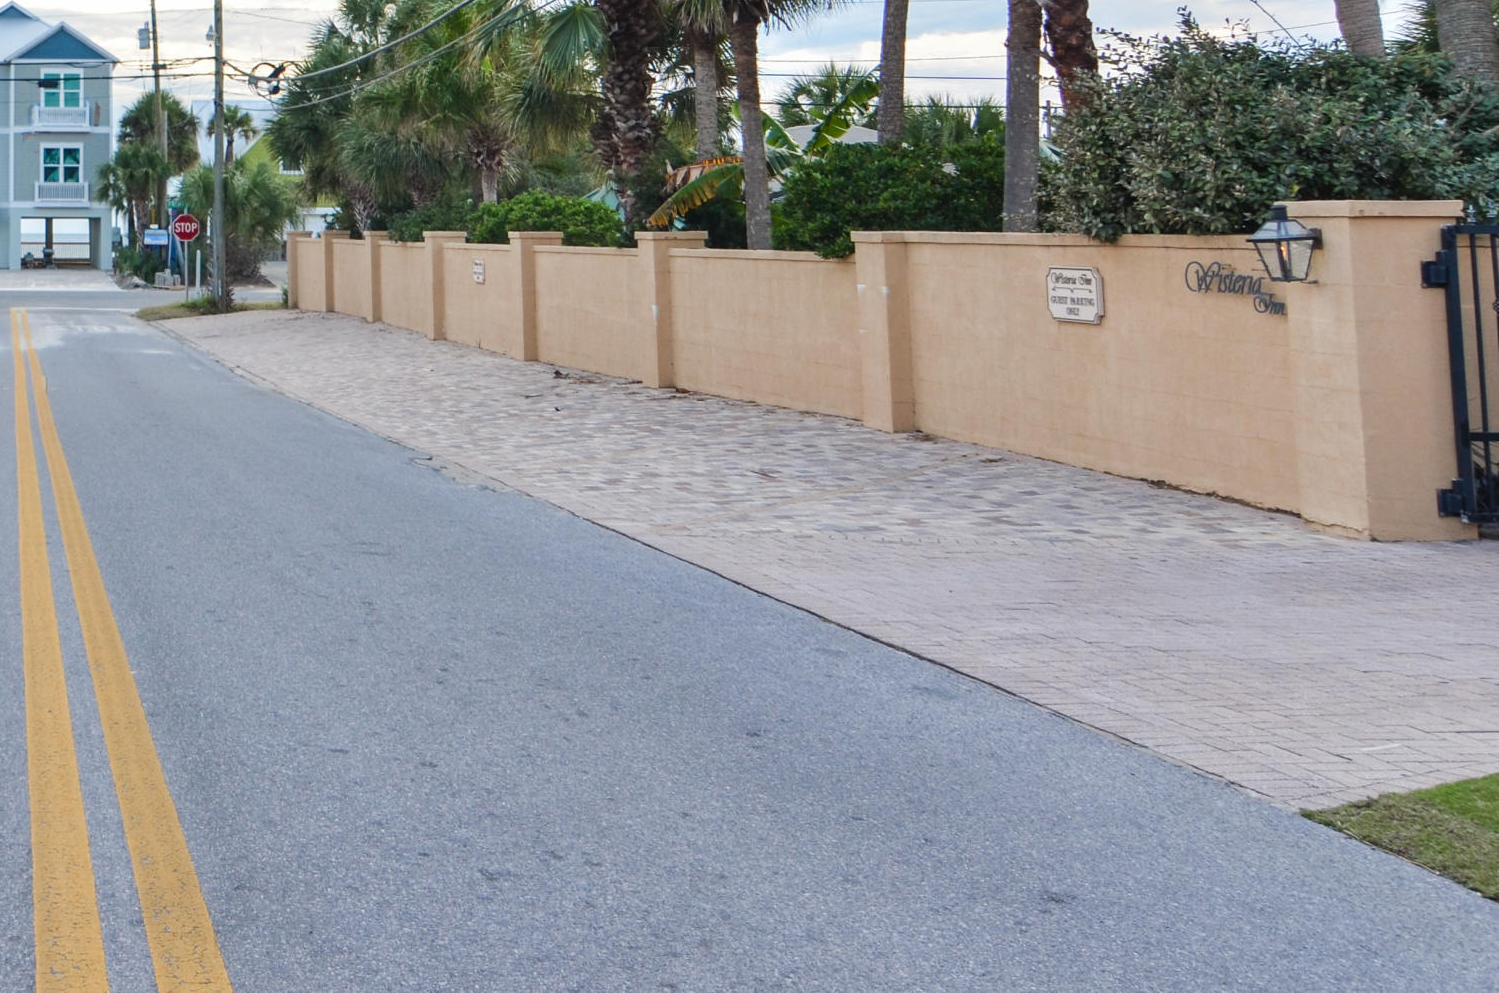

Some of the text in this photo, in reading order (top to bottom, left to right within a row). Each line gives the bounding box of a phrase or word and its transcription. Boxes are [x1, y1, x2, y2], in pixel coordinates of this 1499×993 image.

[175, 223, 198, 233] STOP
[1185, 261, 1264, 295] Wisteria
[1253, 293, 1286, 316] Inn
